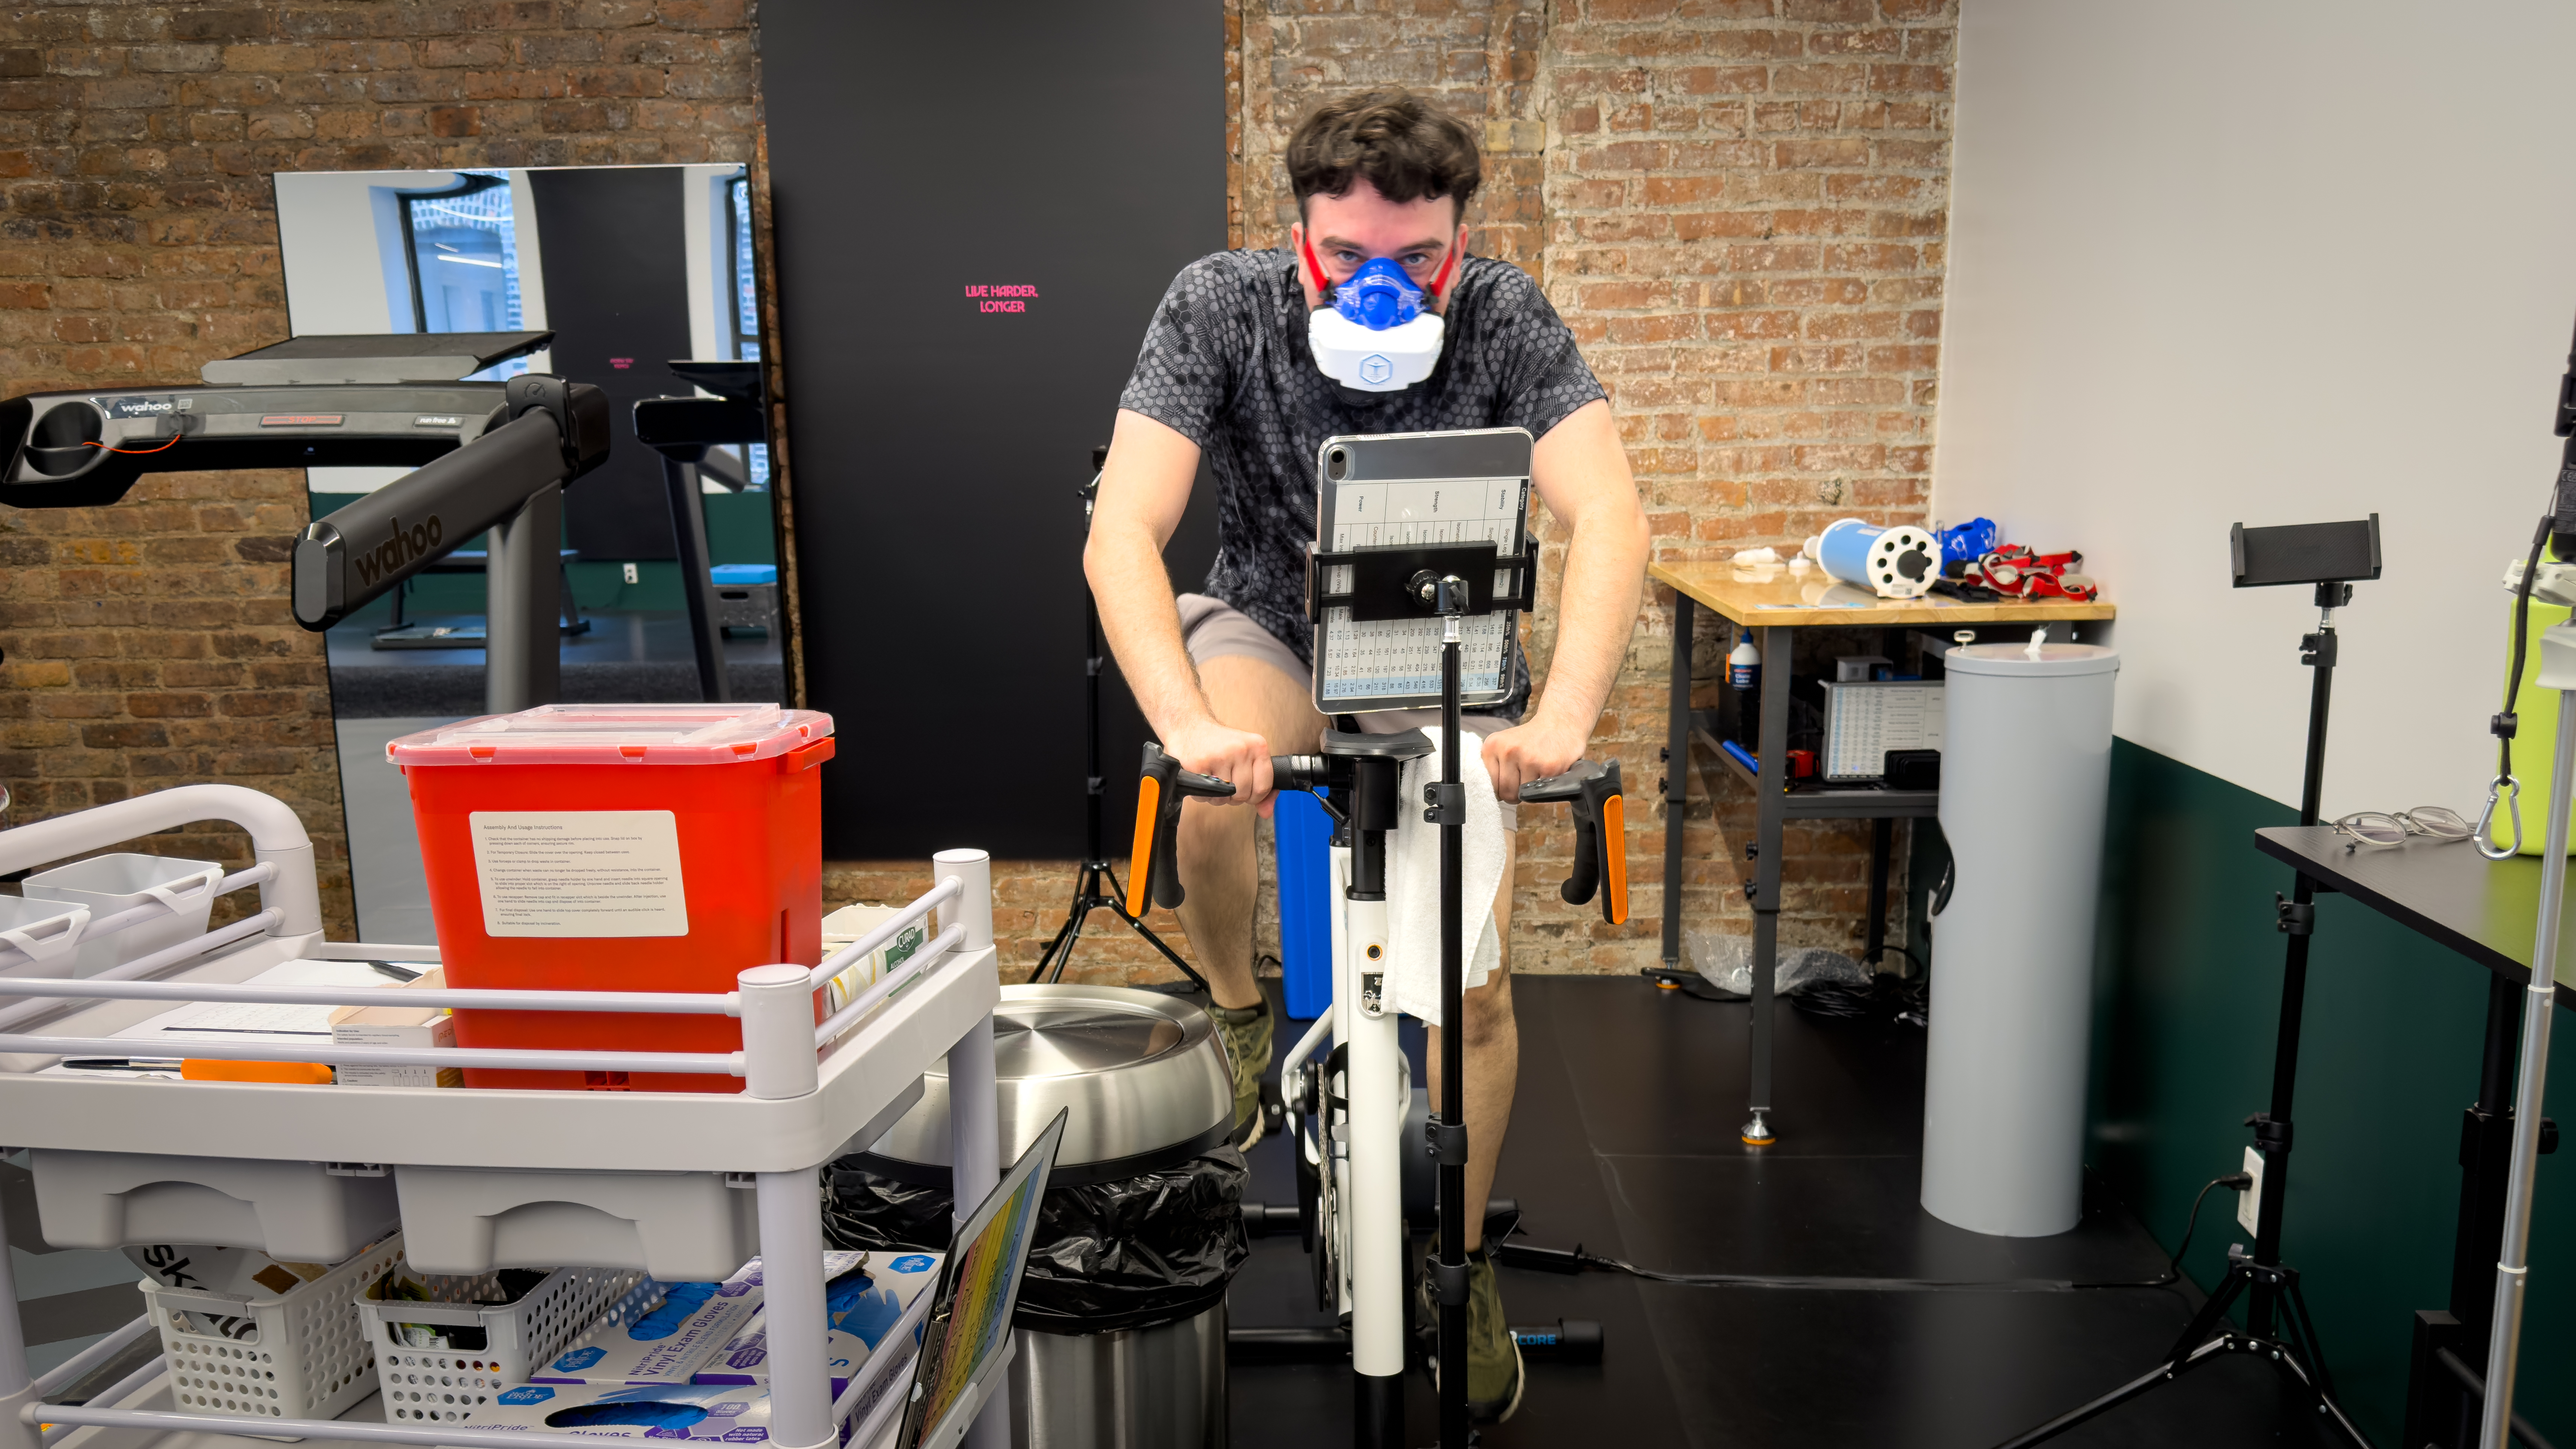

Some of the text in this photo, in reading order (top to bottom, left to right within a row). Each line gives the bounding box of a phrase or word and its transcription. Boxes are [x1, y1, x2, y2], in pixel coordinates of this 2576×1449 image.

[965, 285, 1039, 298] LIVE HARDER,
[980, 301, 1026, 313] LONGER
[121, 401, 172, 412] wahoo
[354, 515, 442, 587] wahoo
[898, 929, 915, 948] CURAD
[891, 956, 905, 970] ALCOHOL
[642, 1349, 677, 1376] Vinyl
[672, 1328, 701, 1352] Exam
[692, 1301, 728, 1327] Gloves
[663, 1364, 678, 1376] VINYL
[680, 1343, 700, 1362] NITRILE
[696, 1330, 713, 1345] BLEND
[709, 1304, 739, 1333] FORMULATION
[855, 1401, 870, 1423] Vinyl
[872, 1383, 888, 1406] Exam
[889, 1352, 908, 1383] Gloves
